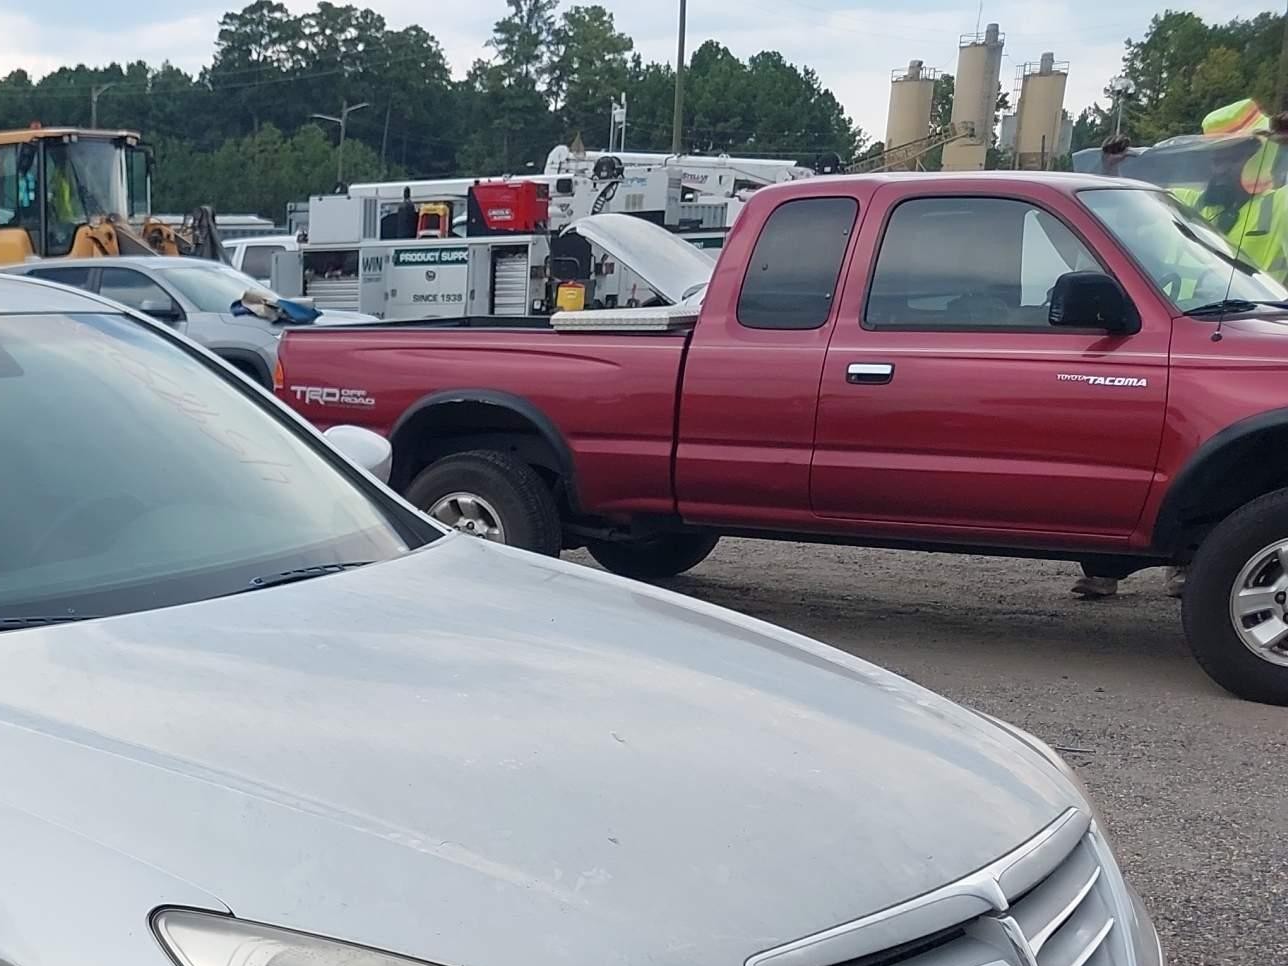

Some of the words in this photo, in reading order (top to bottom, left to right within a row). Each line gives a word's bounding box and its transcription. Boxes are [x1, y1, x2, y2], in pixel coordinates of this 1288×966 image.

[399, 251, 440, 262] PRODUCT
[362, 256, 383, 272] WIN
[412, 293, 439, 303] SINCE
[1086, 376, 1147, 387] TACOMA
[290, 385, 340, 405] TRD
[341, 389, 367, 397] OFF
[341, 396, 375, 405] ROAD
